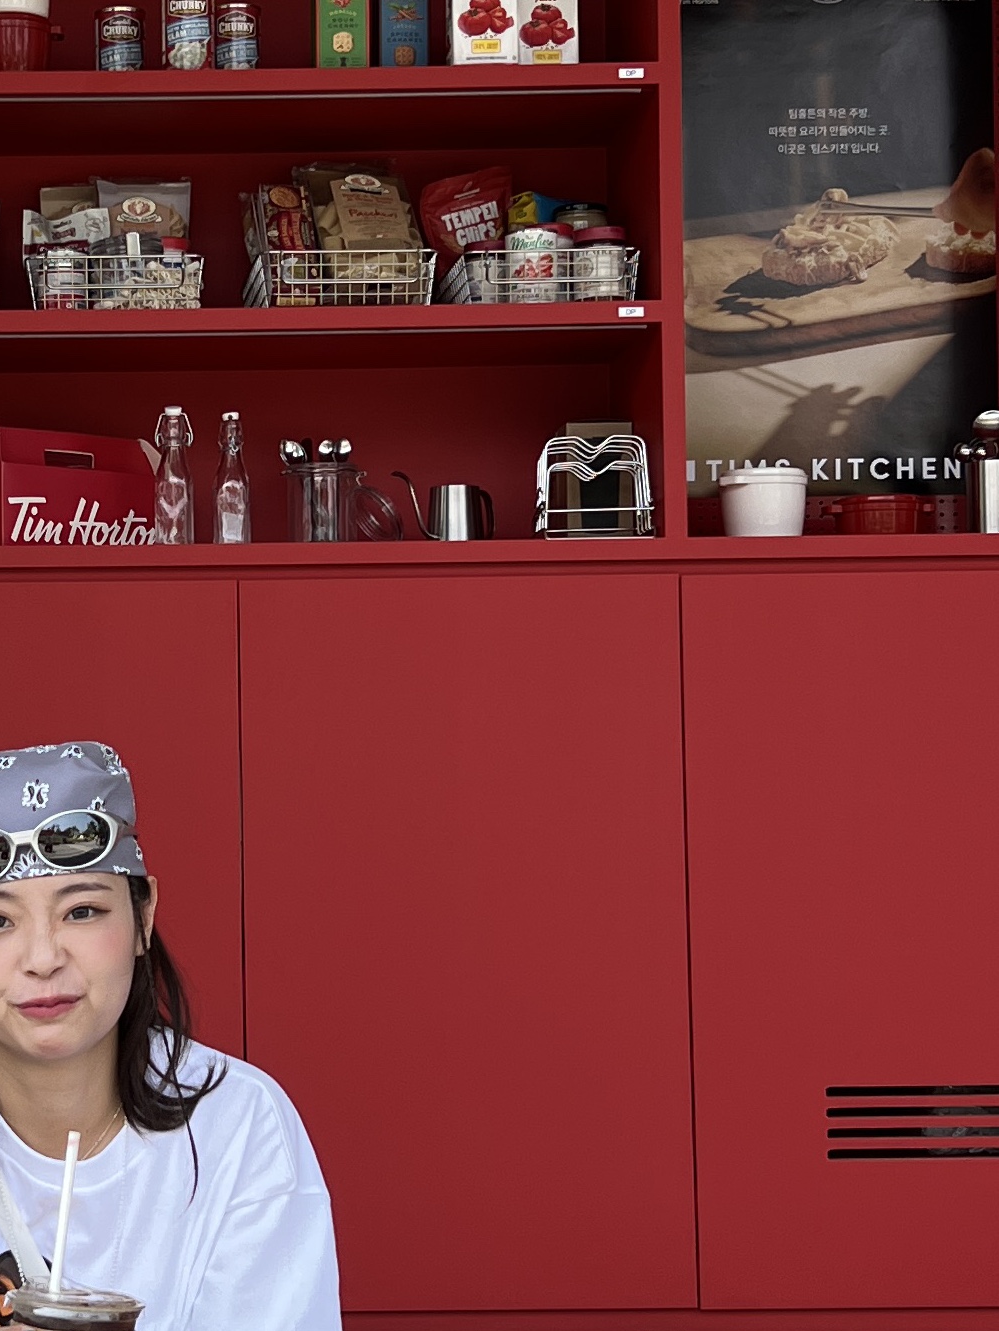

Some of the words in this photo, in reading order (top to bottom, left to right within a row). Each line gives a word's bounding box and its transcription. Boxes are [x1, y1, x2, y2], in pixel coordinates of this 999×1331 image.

[768, 125, 797, 138] 따뜻한
[799, 125, 827, 137] 요리가
[829, 124, 877, 137] 만들어지는
[777, 143, 806, 155] 이곳은
[812, 457, 961, 481] KITCHEN
[7, 496, 63, 545] Tim
[67, 496, 155, 546] Horto
